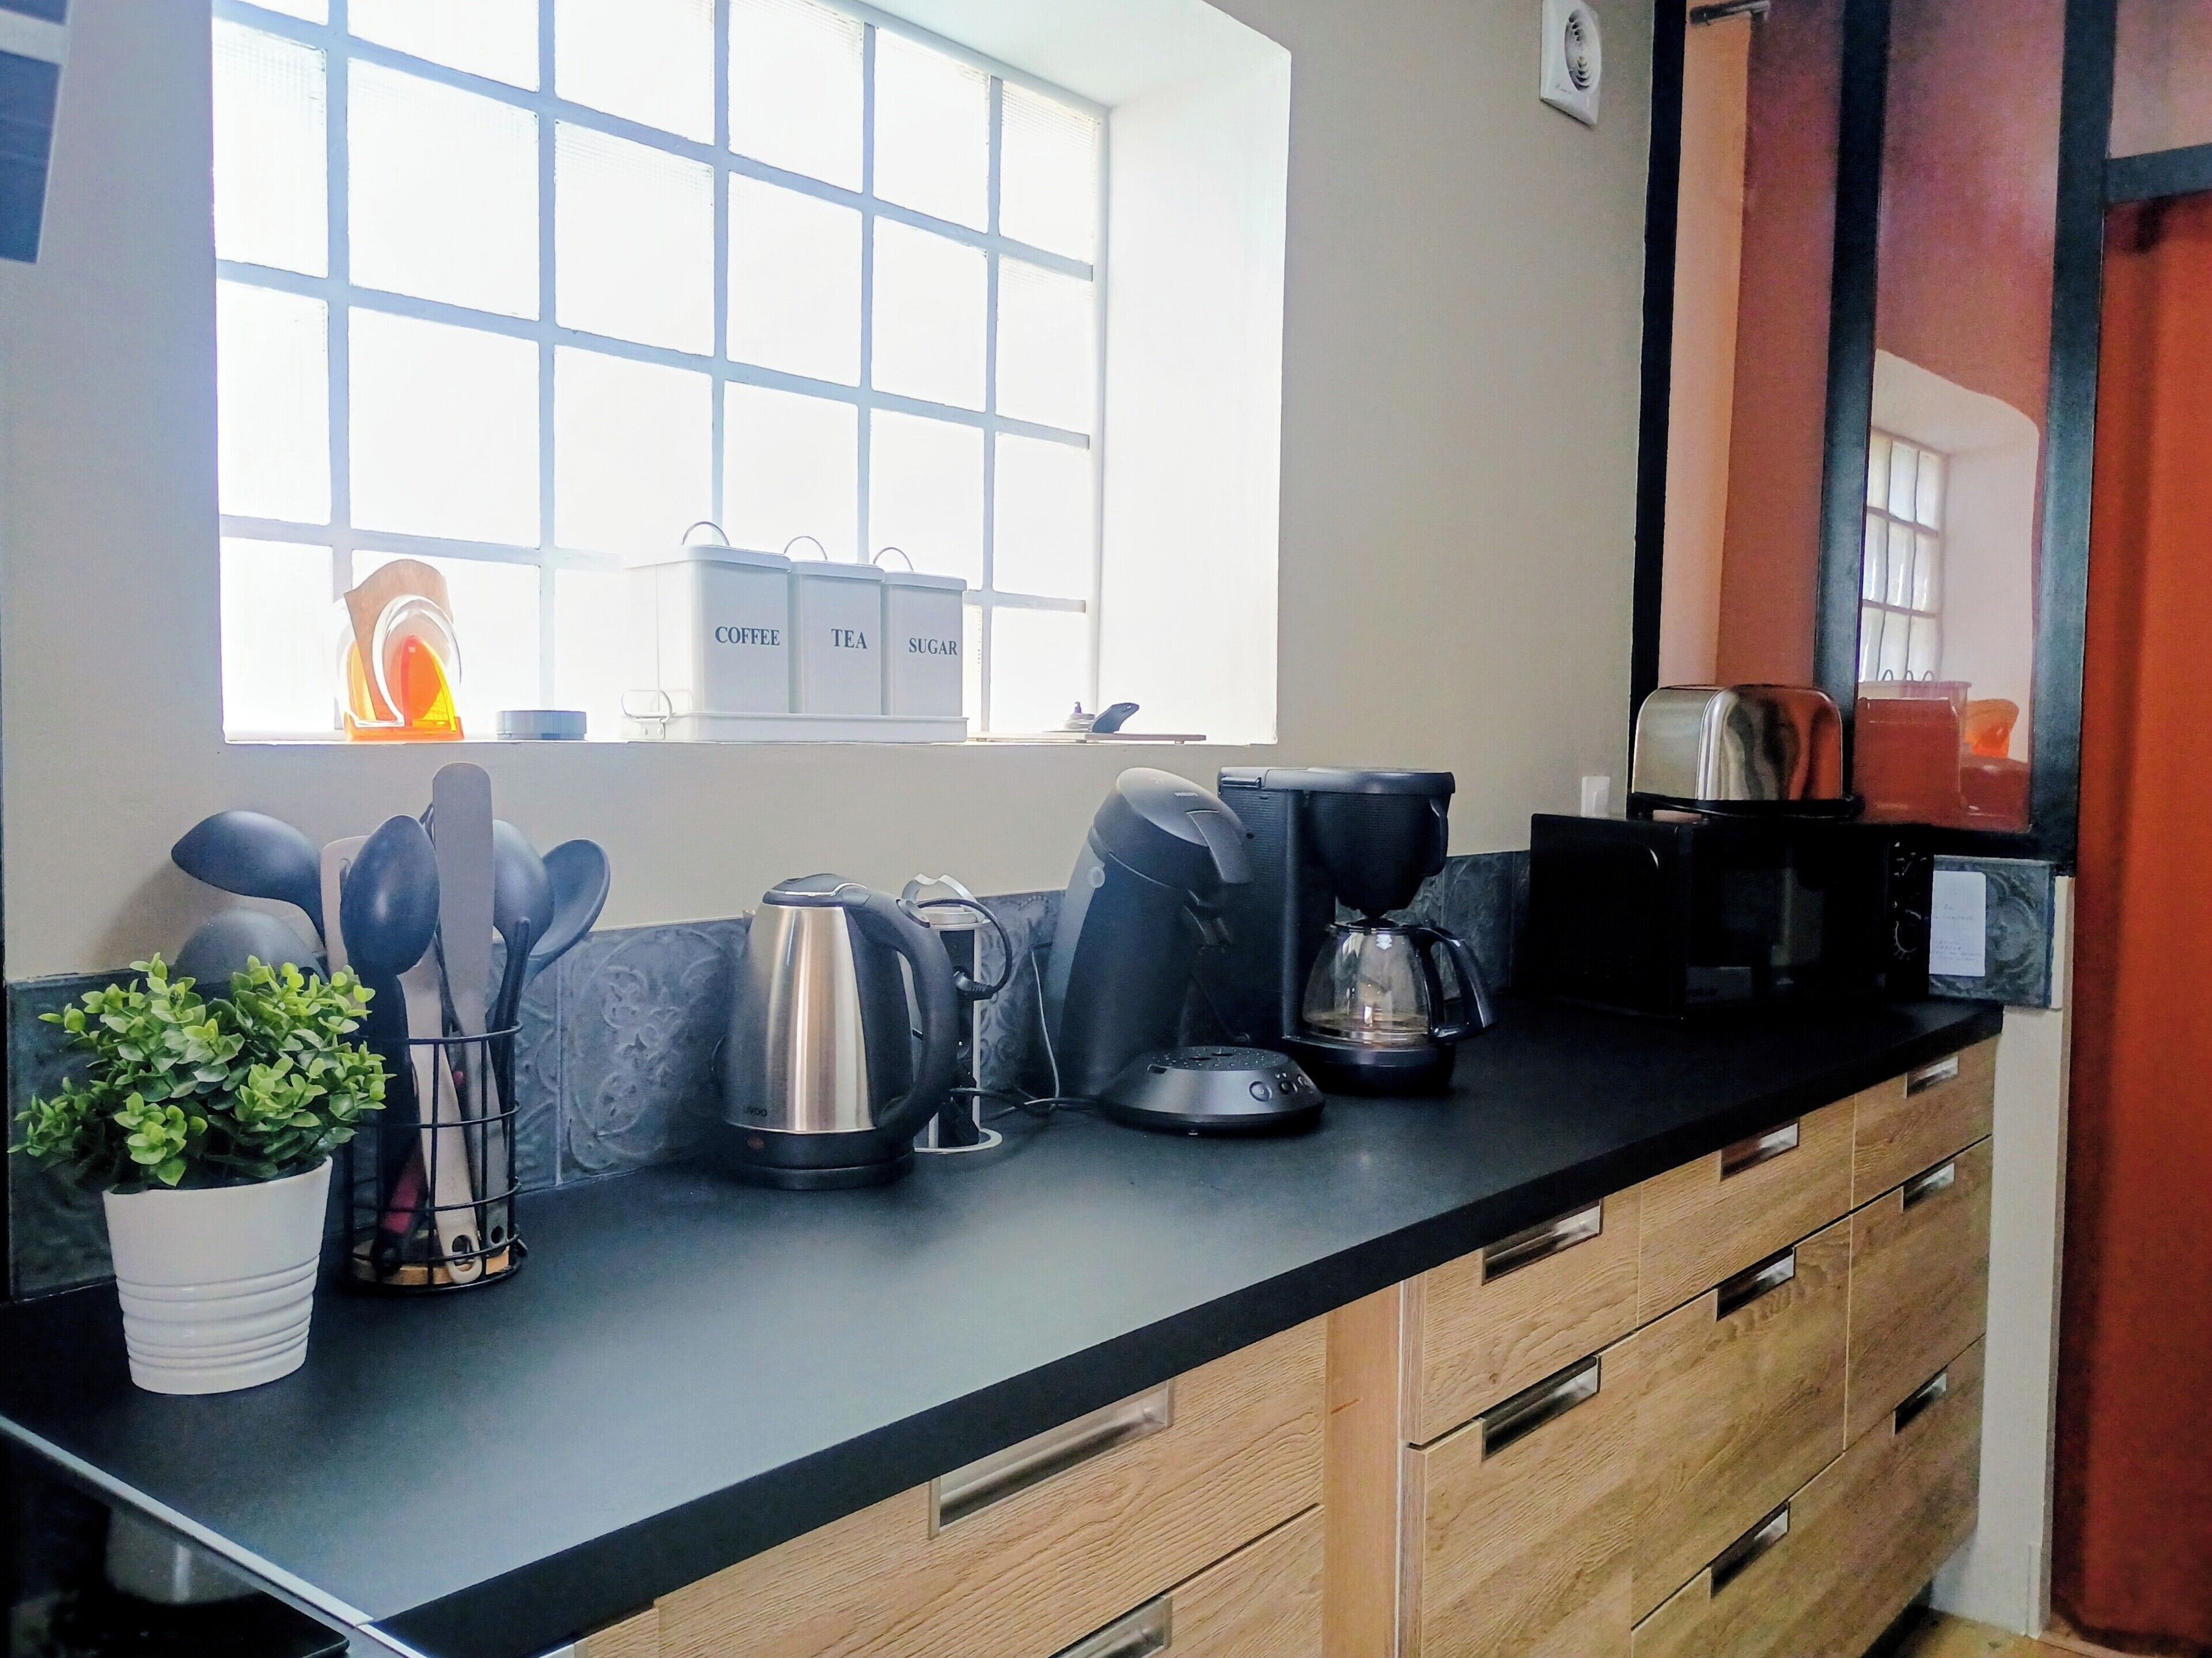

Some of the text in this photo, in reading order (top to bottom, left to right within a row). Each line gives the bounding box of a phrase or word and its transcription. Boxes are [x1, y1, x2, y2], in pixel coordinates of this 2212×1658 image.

[715, 626, 781, 646] COFFEE
[831, 628, 868, 649] TEA
[909, 638, 957, 655] SUGAR
